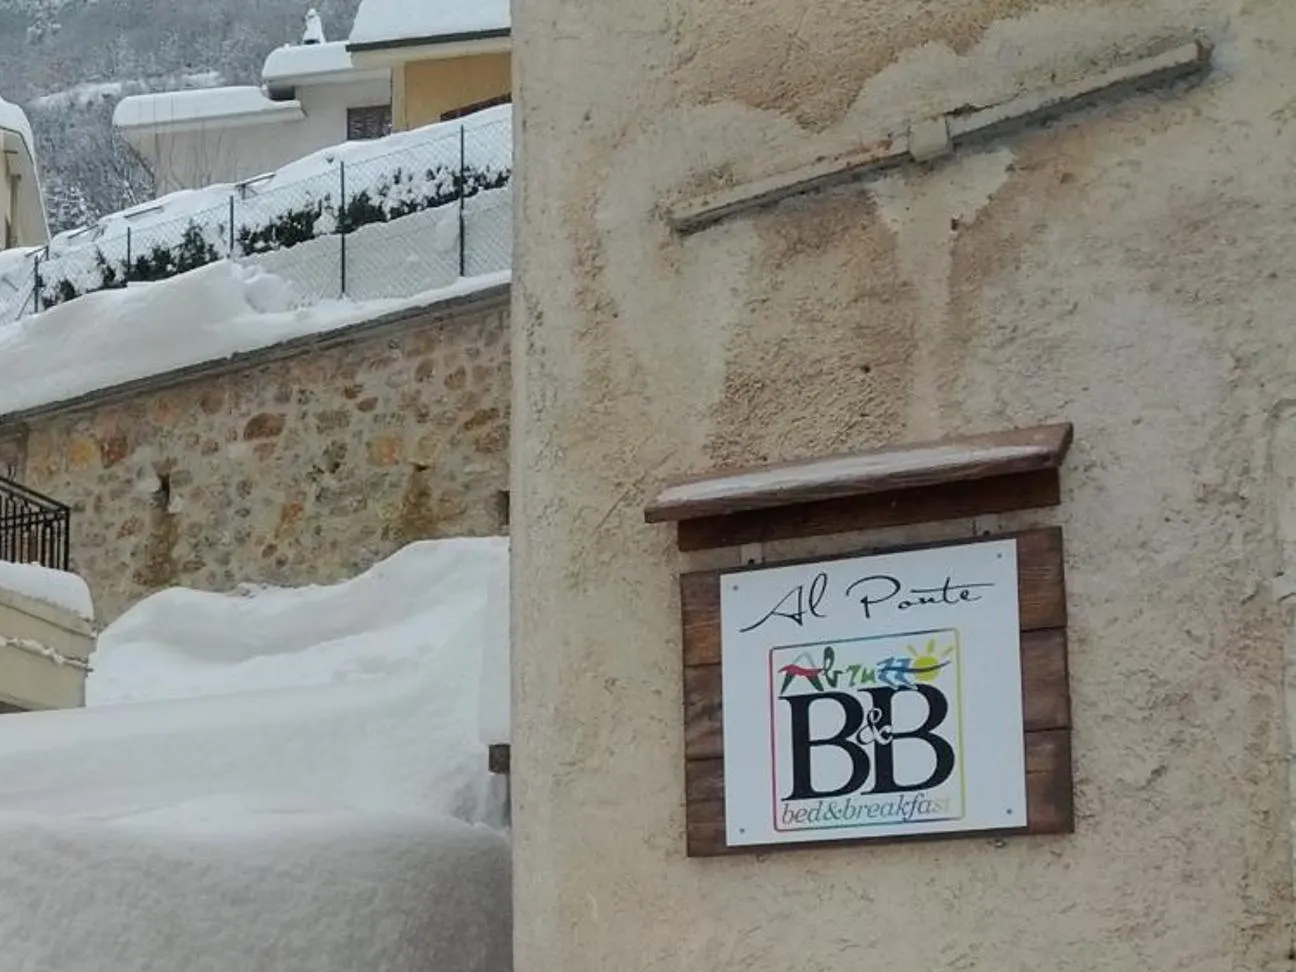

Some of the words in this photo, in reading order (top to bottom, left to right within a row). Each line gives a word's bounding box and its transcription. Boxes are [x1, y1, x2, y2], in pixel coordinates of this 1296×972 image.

[739, 572, 829, 633] Al
[845, 574, 996, 619] Ponte
[777, 683, 956, 802] B&B
